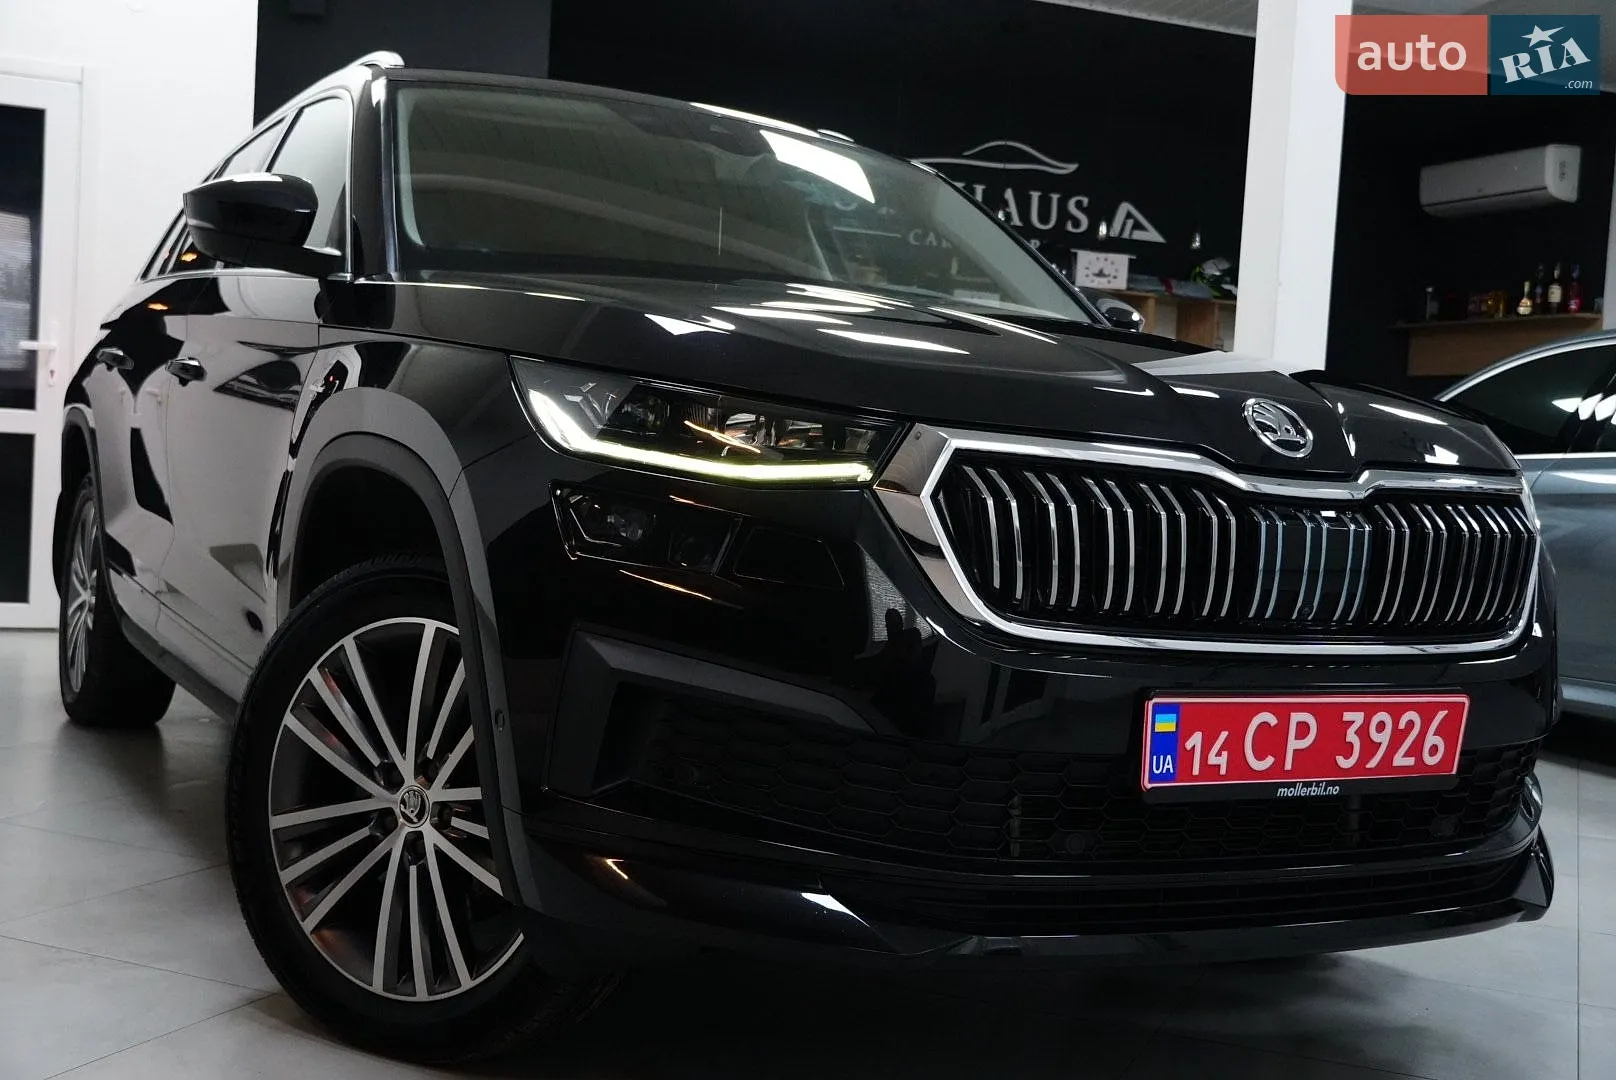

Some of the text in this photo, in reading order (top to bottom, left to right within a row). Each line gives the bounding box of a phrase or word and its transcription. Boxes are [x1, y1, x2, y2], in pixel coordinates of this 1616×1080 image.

[1184, 709, 1449, 776] 14 CP 3926
[1152, 754, 1174, 774] UA
[1276, 782, 1340, 798] mollerbil.no
